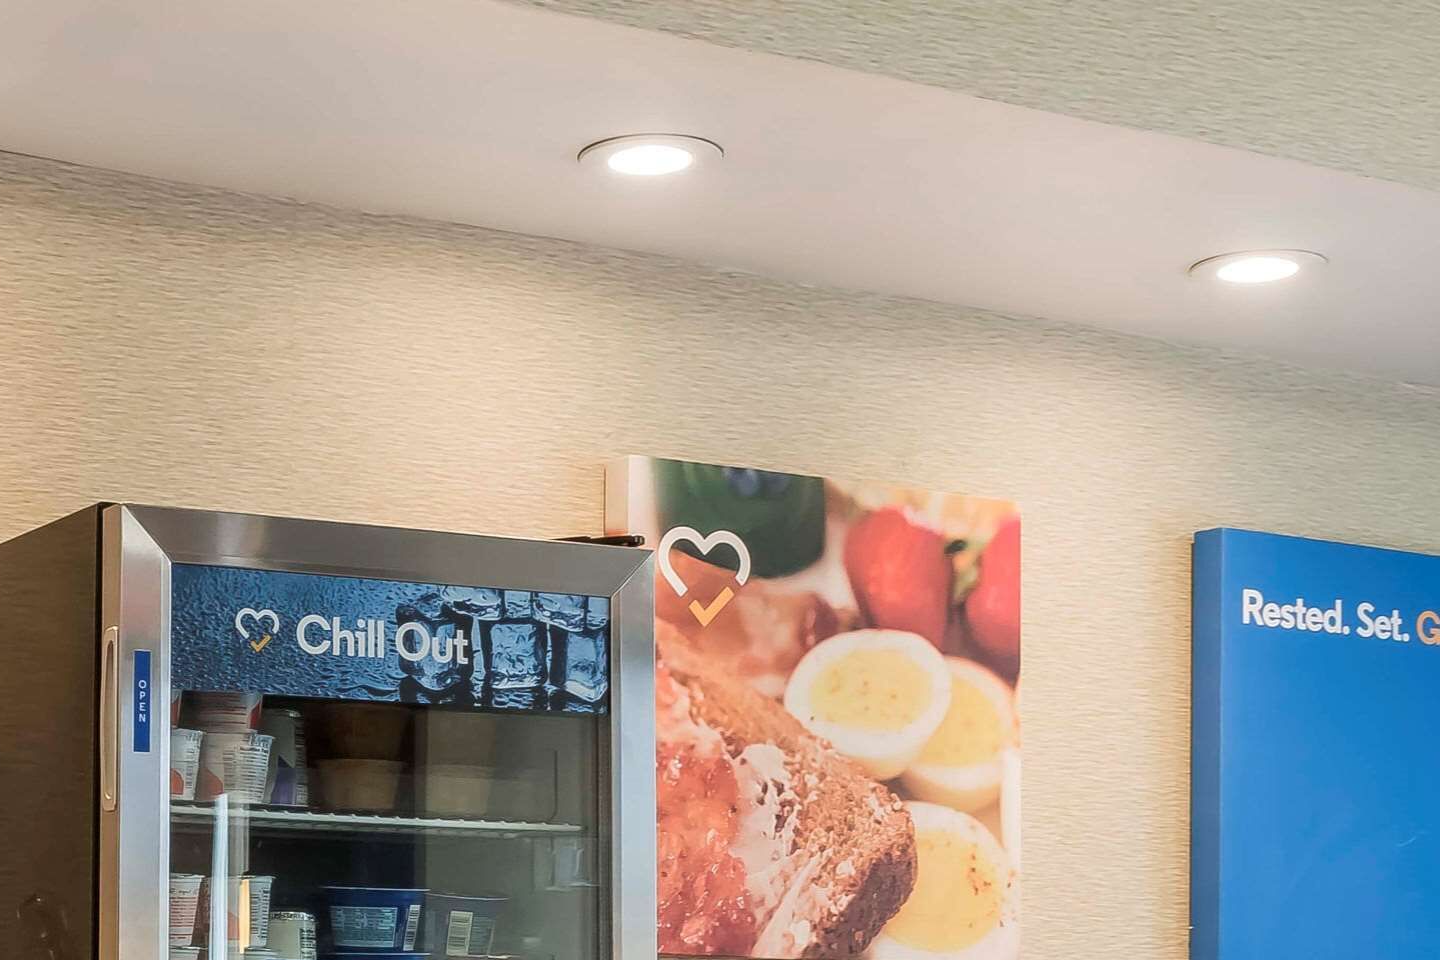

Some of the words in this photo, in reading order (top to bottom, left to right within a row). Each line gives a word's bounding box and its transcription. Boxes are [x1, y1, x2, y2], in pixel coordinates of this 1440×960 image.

[296, 613, 386, 660] Chill
[395, 621, 470, 665] Out
[1241, 588, 1351, 635] Rested.
[1356, 602, 1410, 643] Set.
[1416, 610, 1440, 646] G
[138, 680, 147, 724] OPEN
